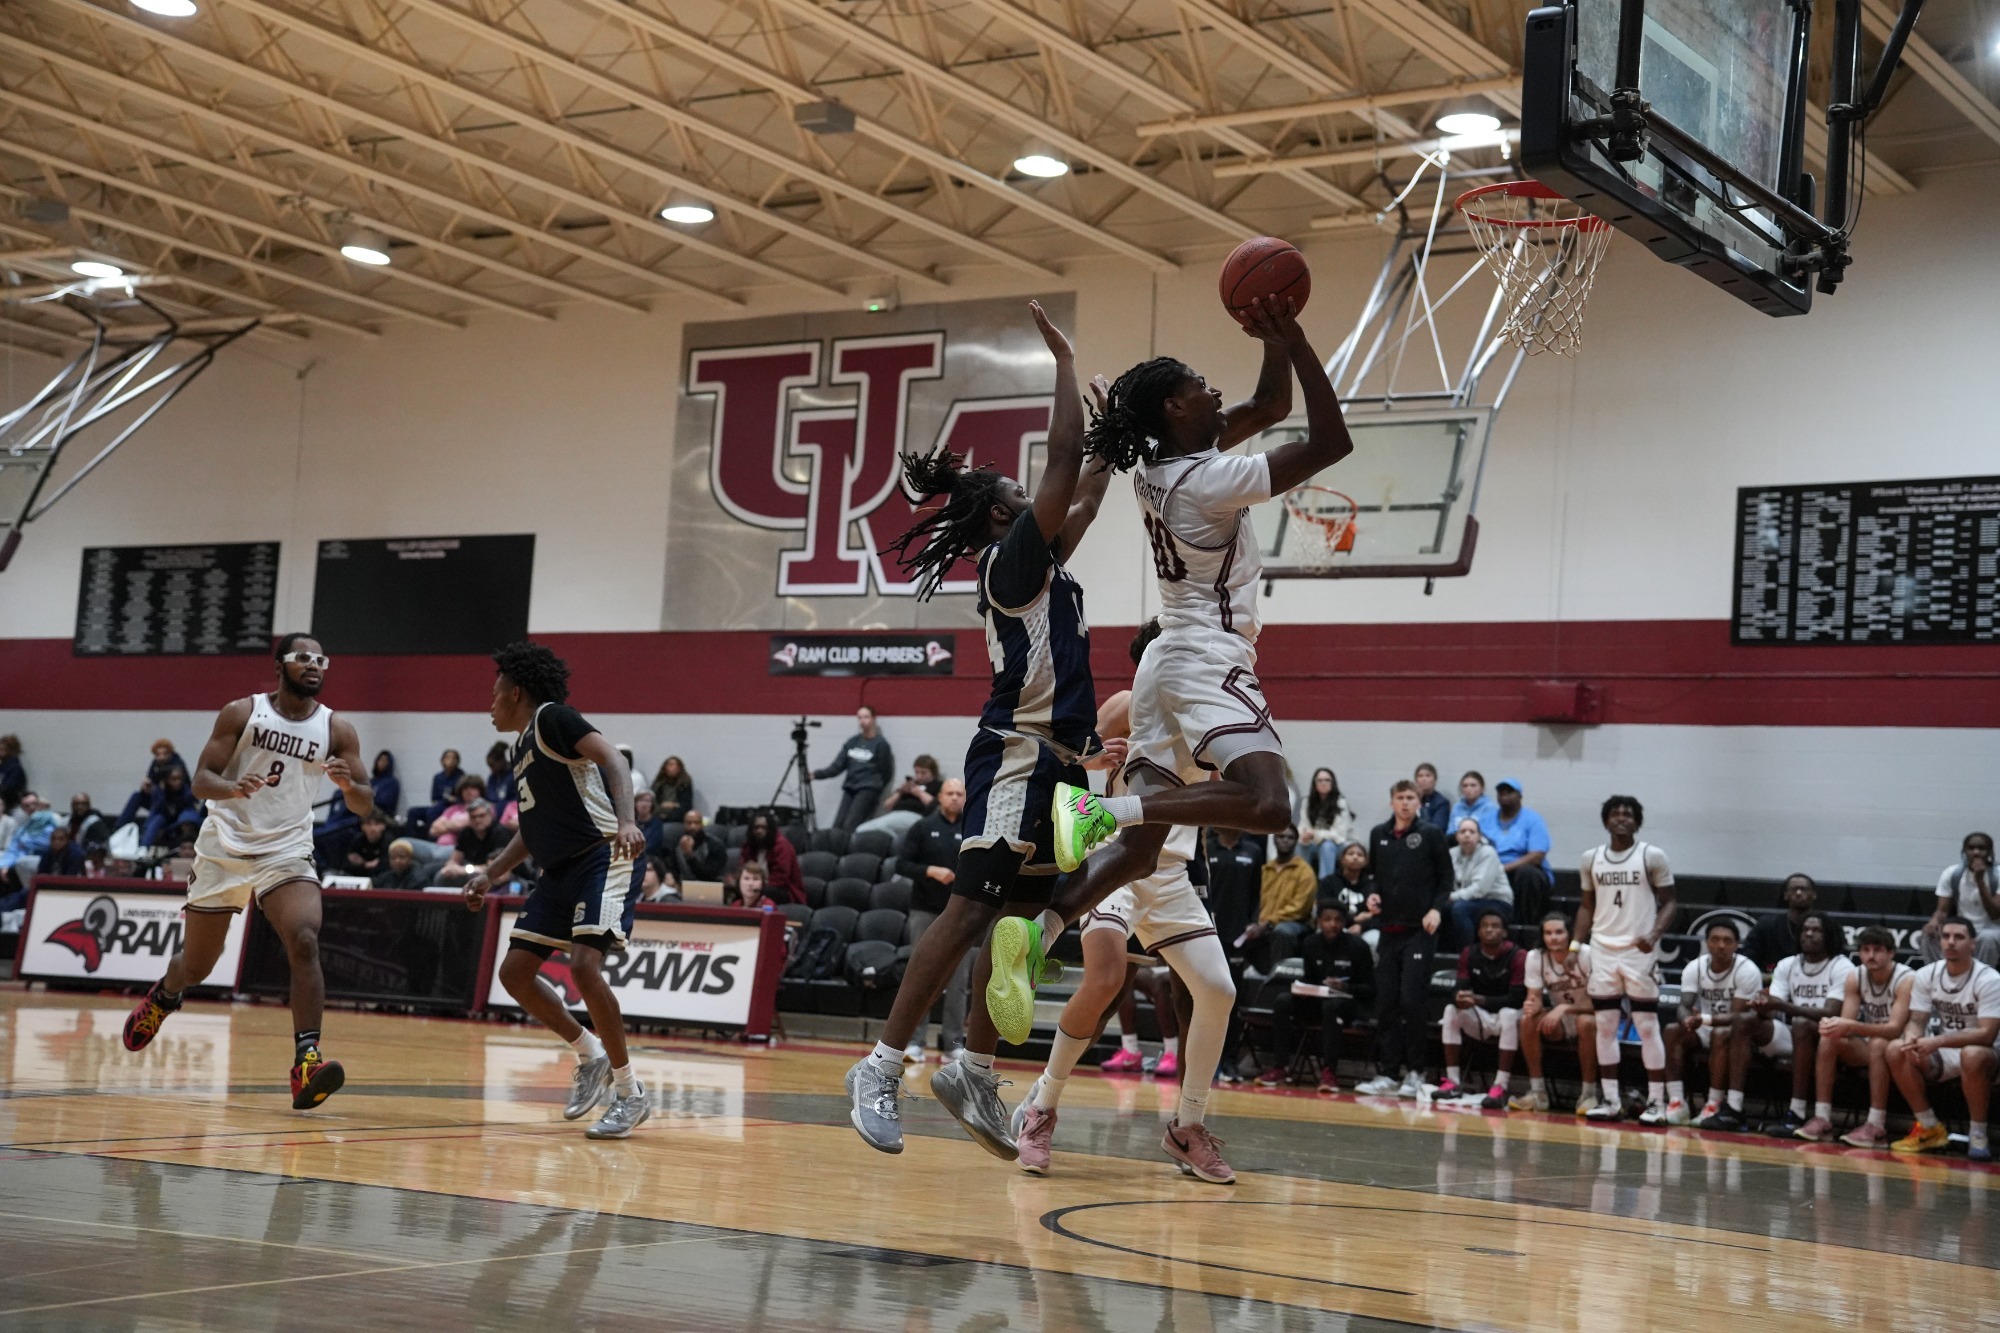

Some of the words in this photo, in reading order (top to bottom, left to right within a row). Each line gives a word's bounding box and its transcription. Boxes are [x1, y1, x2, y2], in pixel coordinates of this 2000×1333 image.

[798, 647, 827, 663] RAM
[828, 647, 860, 664] CLUB
[862, 647, 925, 664] MEMBERS
[251, 726, 320, 764] MOBILE
[265, 760, 285, 788] 8
[1595, 870, 1641, 887] MOBILE
[1613, 889, 1623, 909] 4
[103, 919, 186, 956] RAM
[603, 949, 740, 995] RAMS
